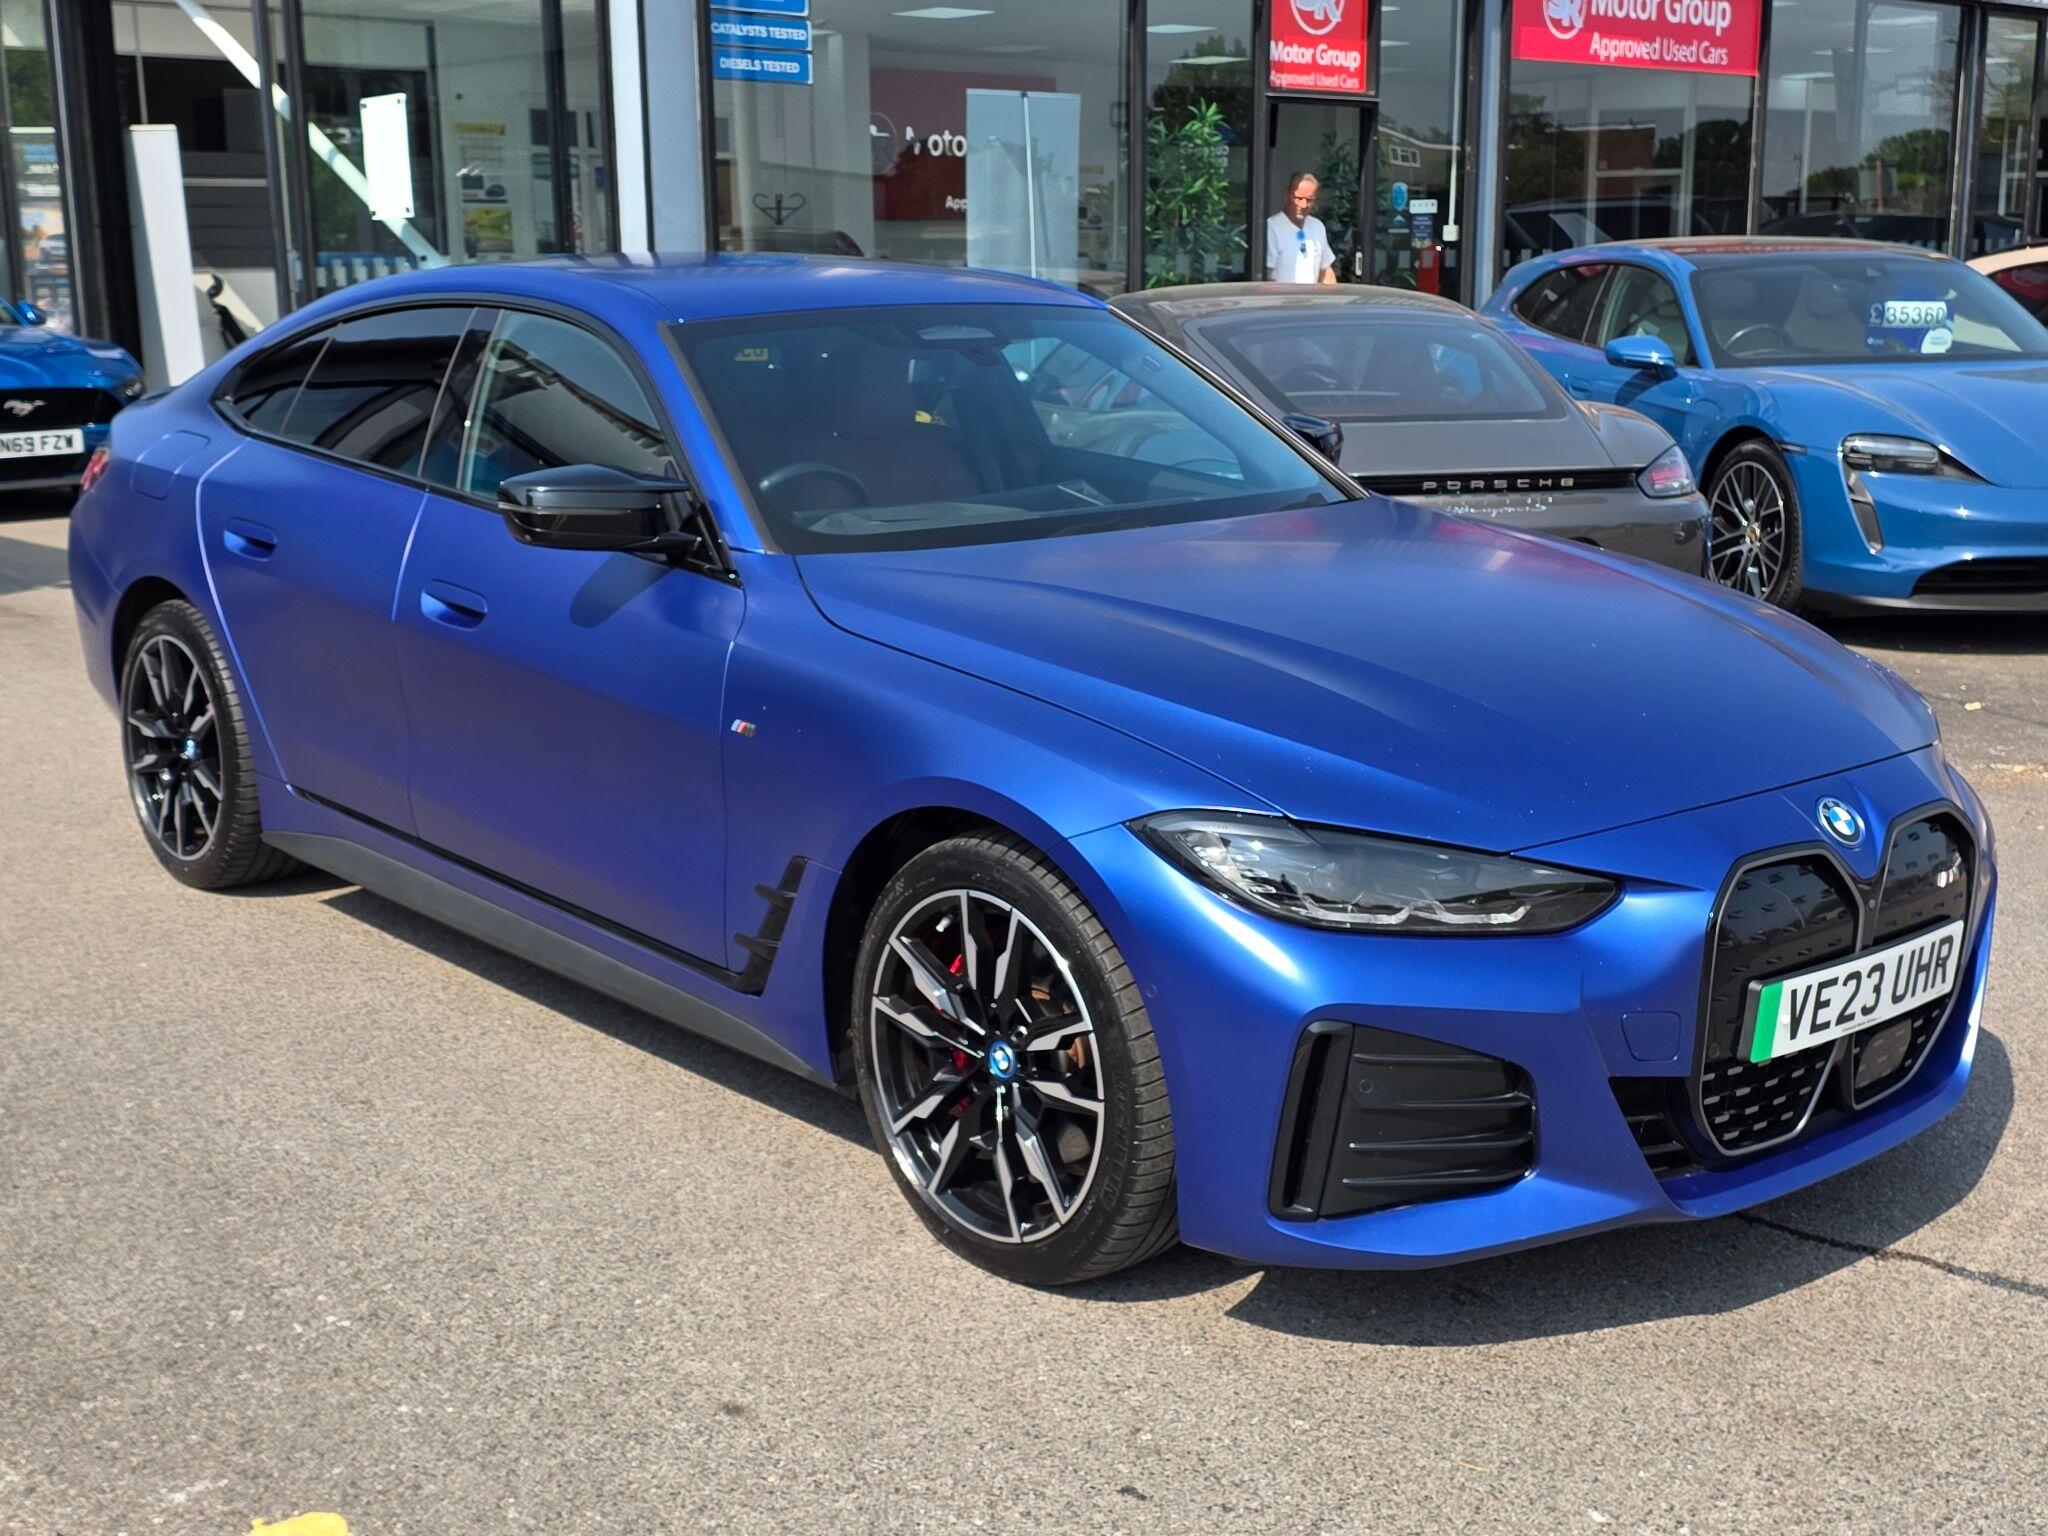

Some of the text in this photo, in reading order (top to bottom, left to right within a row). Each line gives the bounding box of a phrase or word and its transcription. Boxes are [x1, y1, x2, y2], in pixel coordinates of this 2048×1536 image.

[1590, 0, 1732, 36] Motor Group
[711, 22, 807, 40] CATALYSTS TESTED
[1270, 40, 1360, 72] Motor Group
[1589, 32, 1729, 65] Approved Used Cars
[720, 57, 800, 73] DIESELS TESTED
[41, 434, 73, 451] FZW
[1422, 477, 1574, 490] PORSCHE
[1789, 934, 1954, 1041] VE23 UHR
